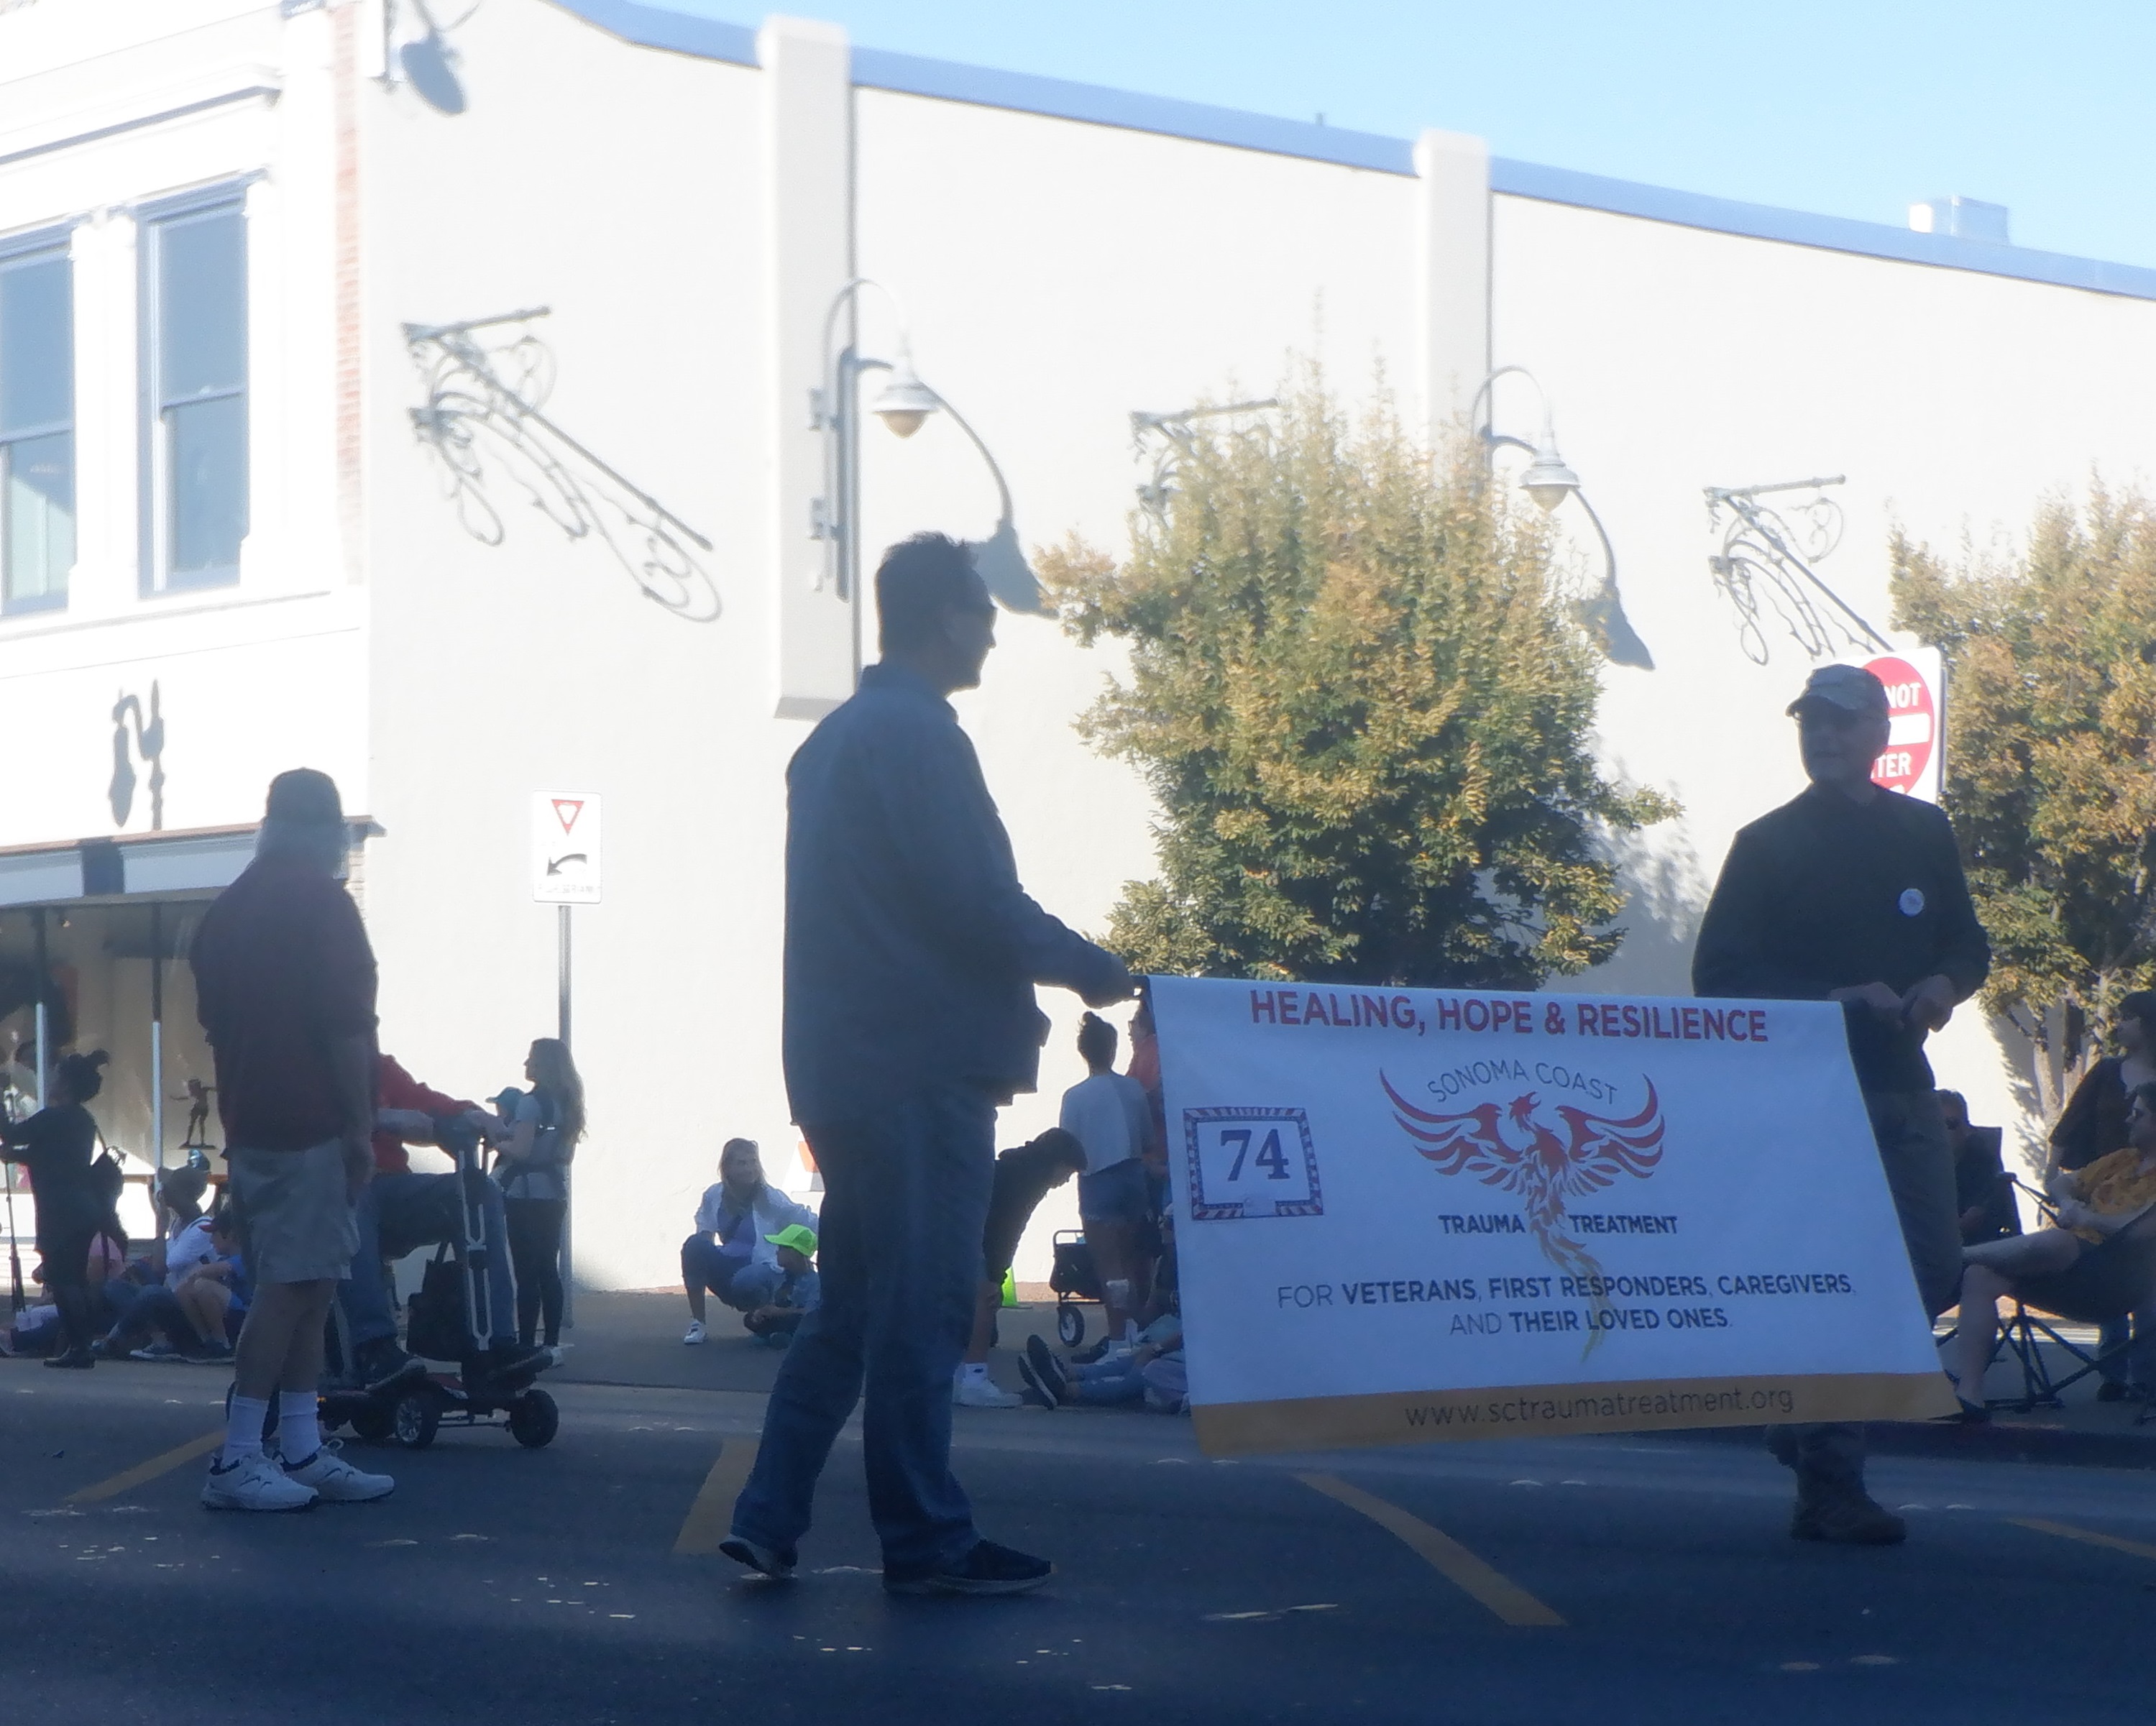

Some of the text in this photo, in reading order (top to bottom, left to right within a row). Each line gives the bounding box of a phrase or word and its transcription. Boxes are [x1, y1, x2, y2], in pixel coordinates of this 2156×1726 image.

[1871, 753, 1911, 779] TER
[1250, 989, 1769, 1042] HEALING, HOPE & RESILIENCE
[1428, 1060, 1618, 1105] SONOMA COAST
[1220, 1129, 1290, 1181] 74
[1438, 1215, 1678, 1234] TRAUMA TREATMENT
[1278, 1285, 1334, 1308] FOR
[1341, 1278, 1482, 1305] VETERANS,
[1489, 1276, 1552, 1299] FIRST
[1560, 1275, 1713, 1298] RESPONDERS,
[1449, 1306, 1733, 1336] AND THEIR LOVED ONES.
[1405, 1388, 1794, 1428] www.sctraumatreatment.org
